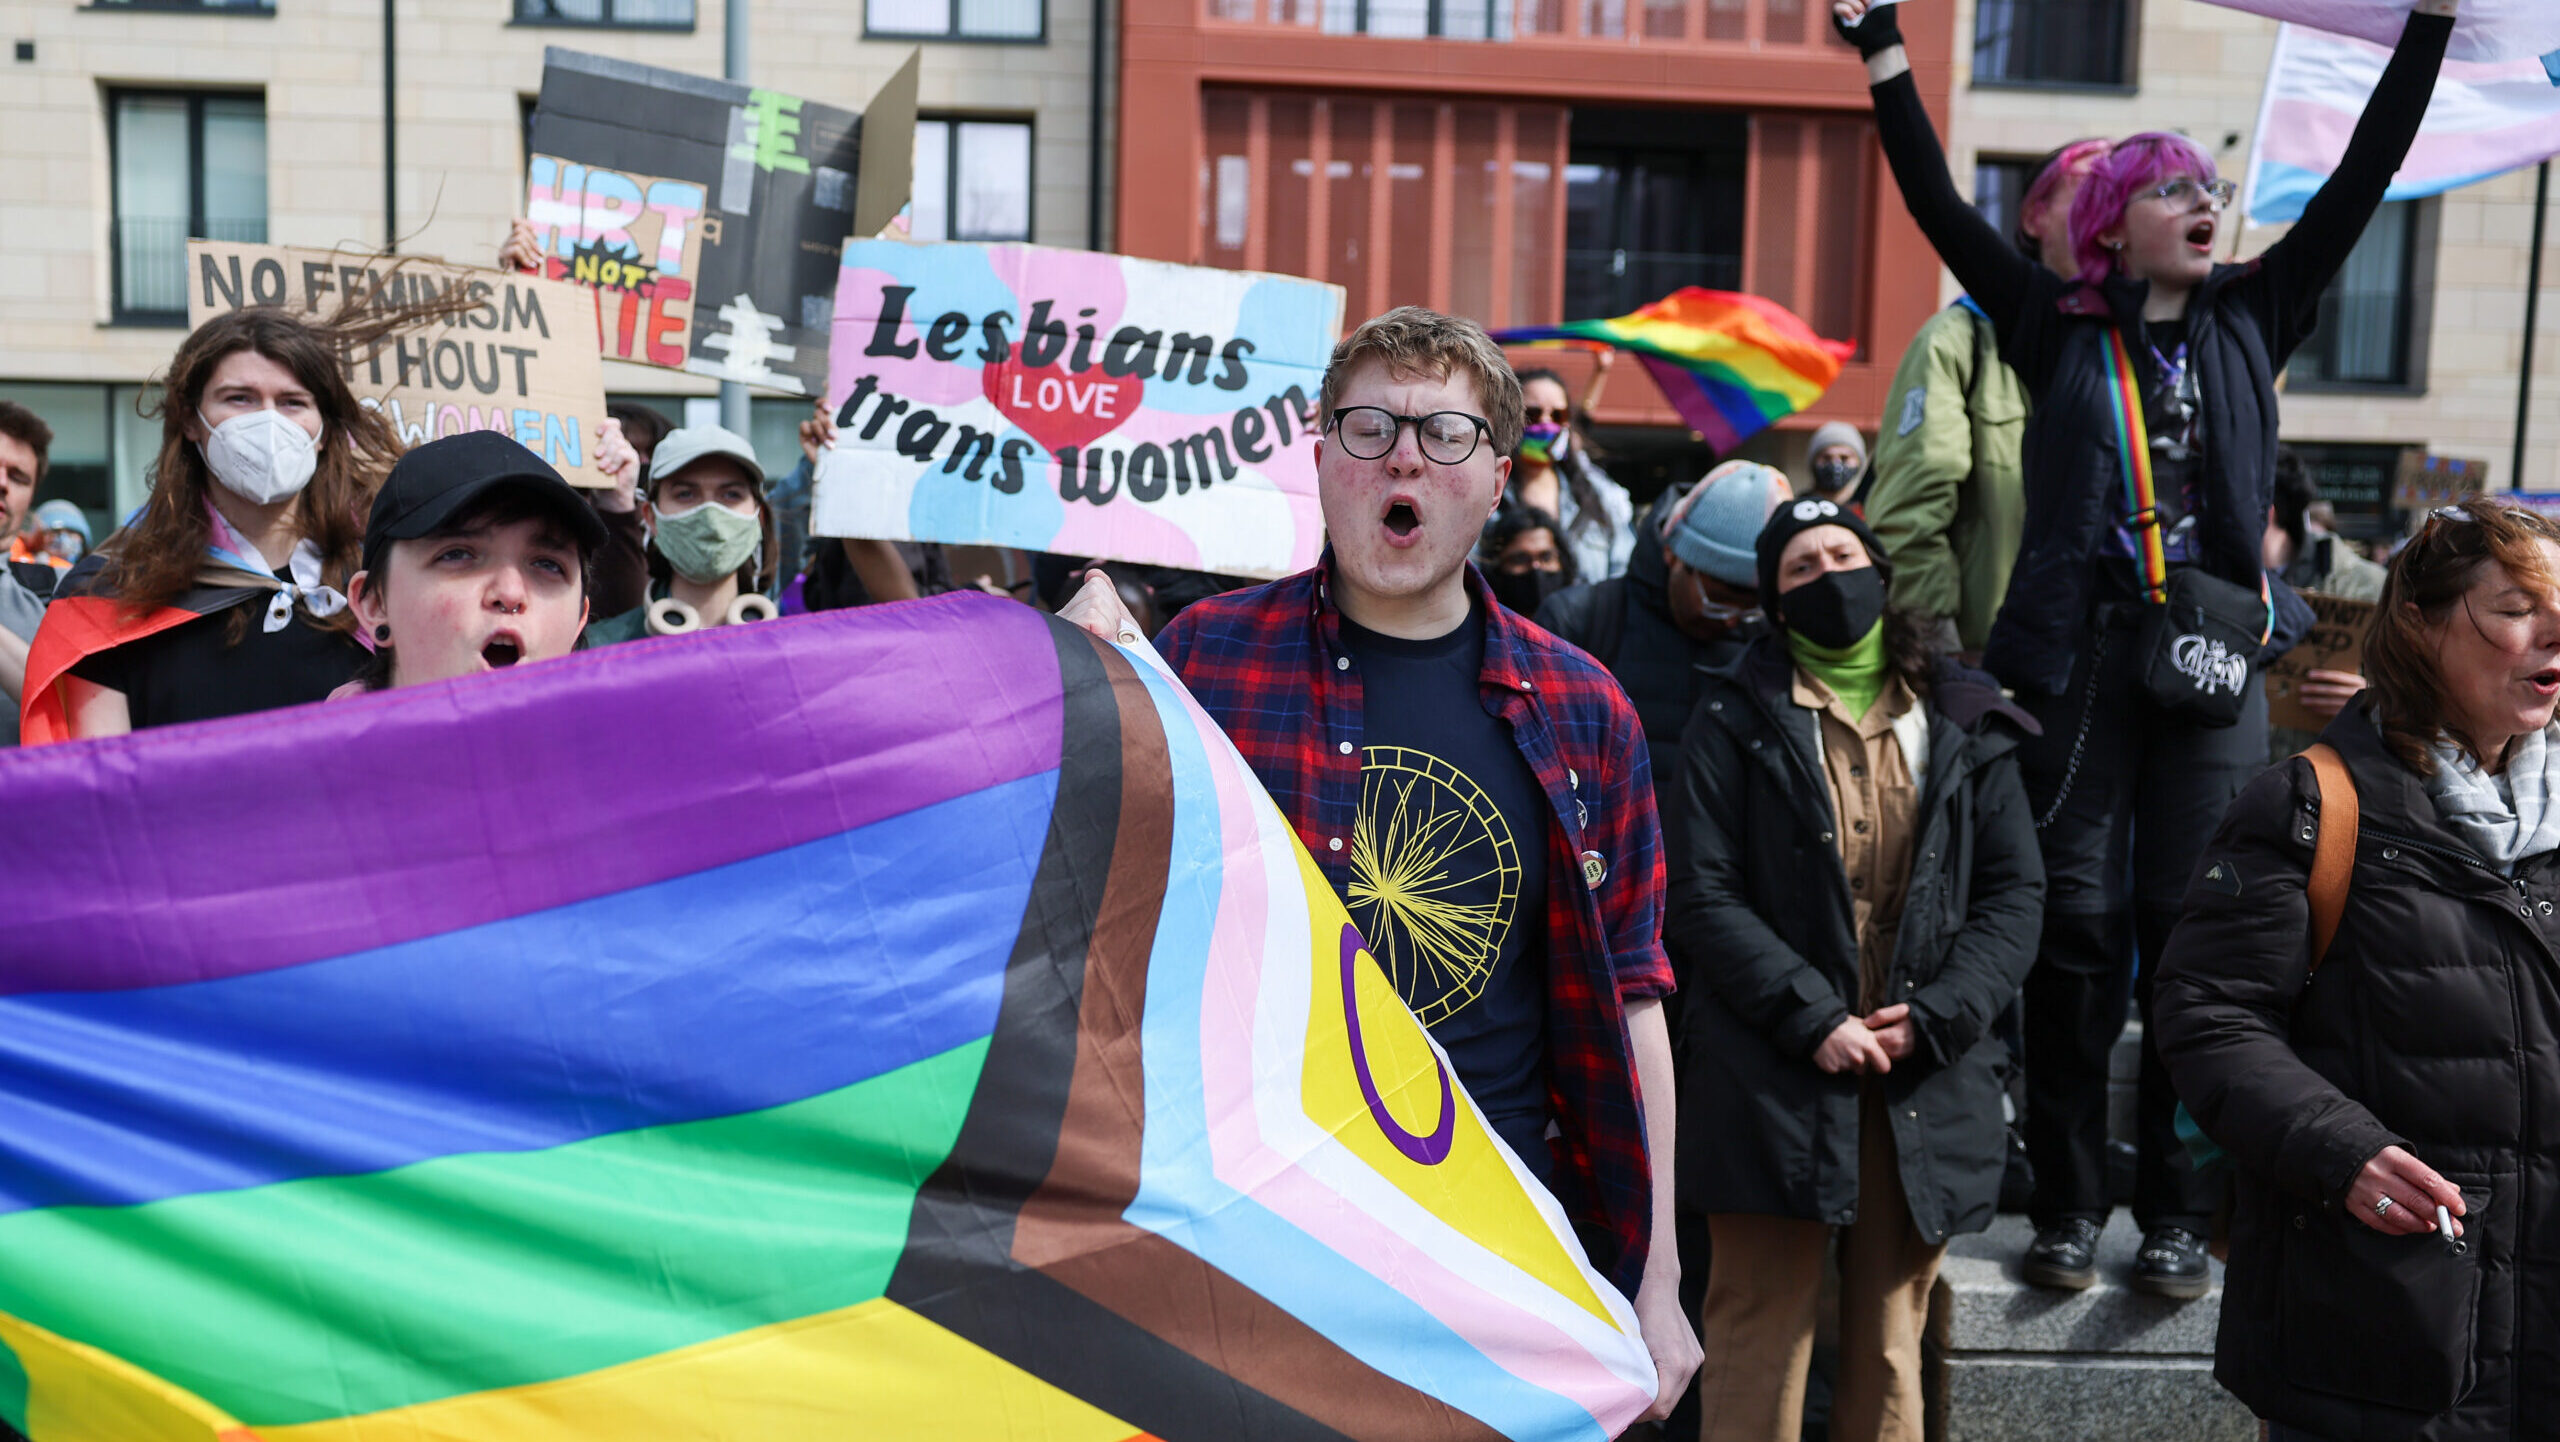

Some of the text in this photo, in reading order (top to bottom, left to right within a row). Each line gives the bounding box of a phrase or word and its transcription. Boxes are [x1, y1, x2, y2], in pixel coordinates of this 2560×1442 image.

[527, 156, 704, 276] HRT
[200, 253, 555, 339] NO FEMINISM
[519, 256, 691, 366] TE
[574, 254, 647, 289] NOT
[336, 332, 538, 397] ITHOUT
[863, 285, 1256, 392] Lesbians
[836, 374, 1309, 506] trans women
[1011, 374, 1119, 419] LOVE
